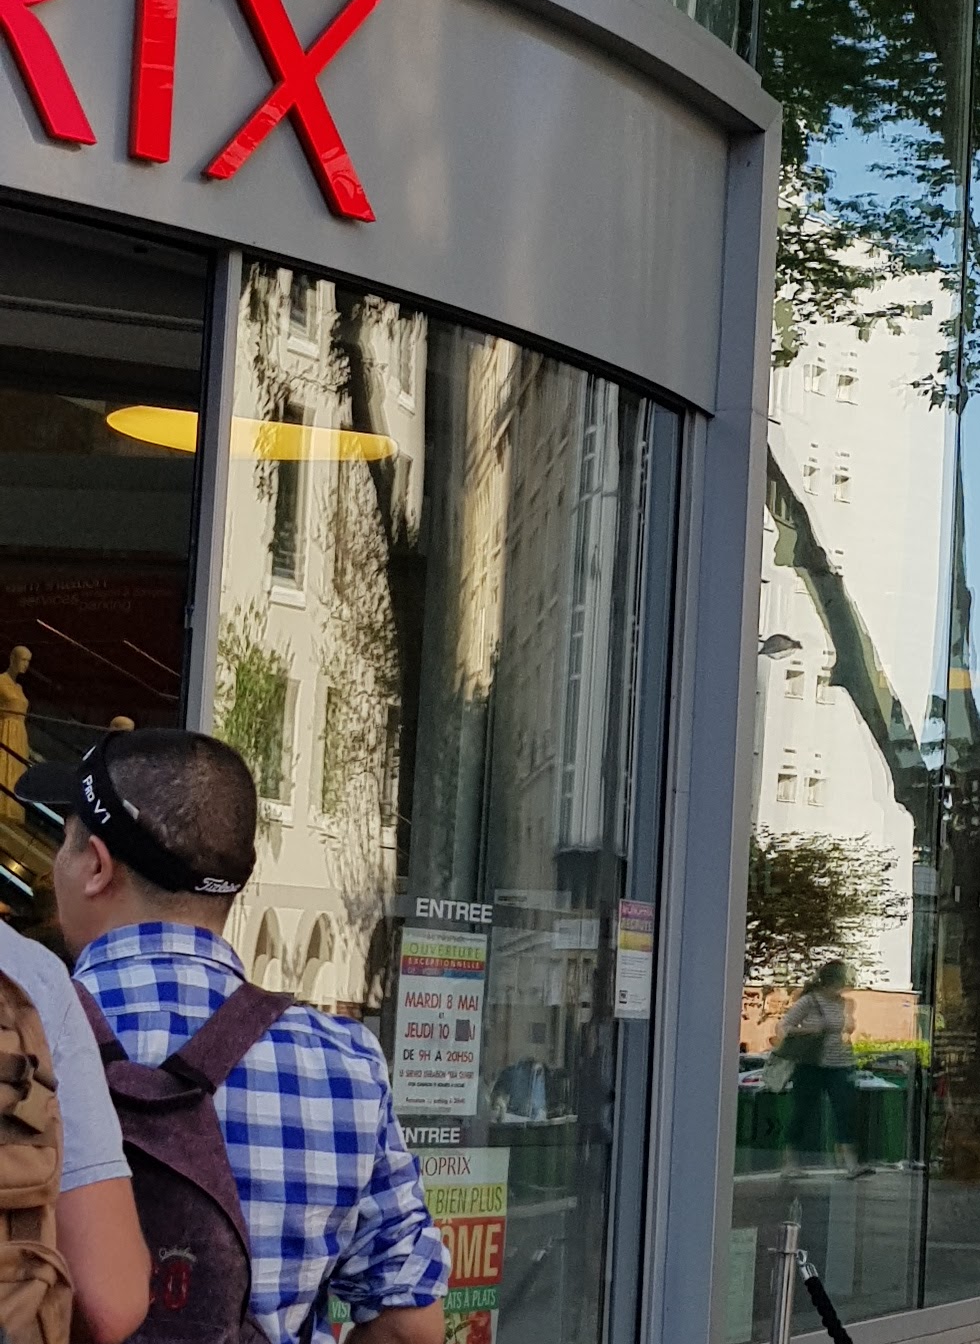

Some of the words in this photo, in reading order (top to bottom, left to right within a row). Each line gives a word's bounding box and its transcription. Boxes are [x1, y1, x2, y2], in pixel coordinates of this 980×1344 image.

[415, 897, 494, 924] ENTREE
[409, 942, 481, 960] OUVERTURE
[404, 991, 442, 1009] MARDI
[446, 994, 454, 1010] 8
[457, 995, 480, 1012] MAI
[404, 1022, 434, 1040] JEUDI
[438, 1023, 450, 1040] 10
[402, 1049, 415, 1061] DE
[418, 1050, 431, 1062] 9H
[435, 1187, 468, 1214] BIEN
[470, 1186, 503, 1213] PLUS
[472, 1288, 497, 1307] PLATS
